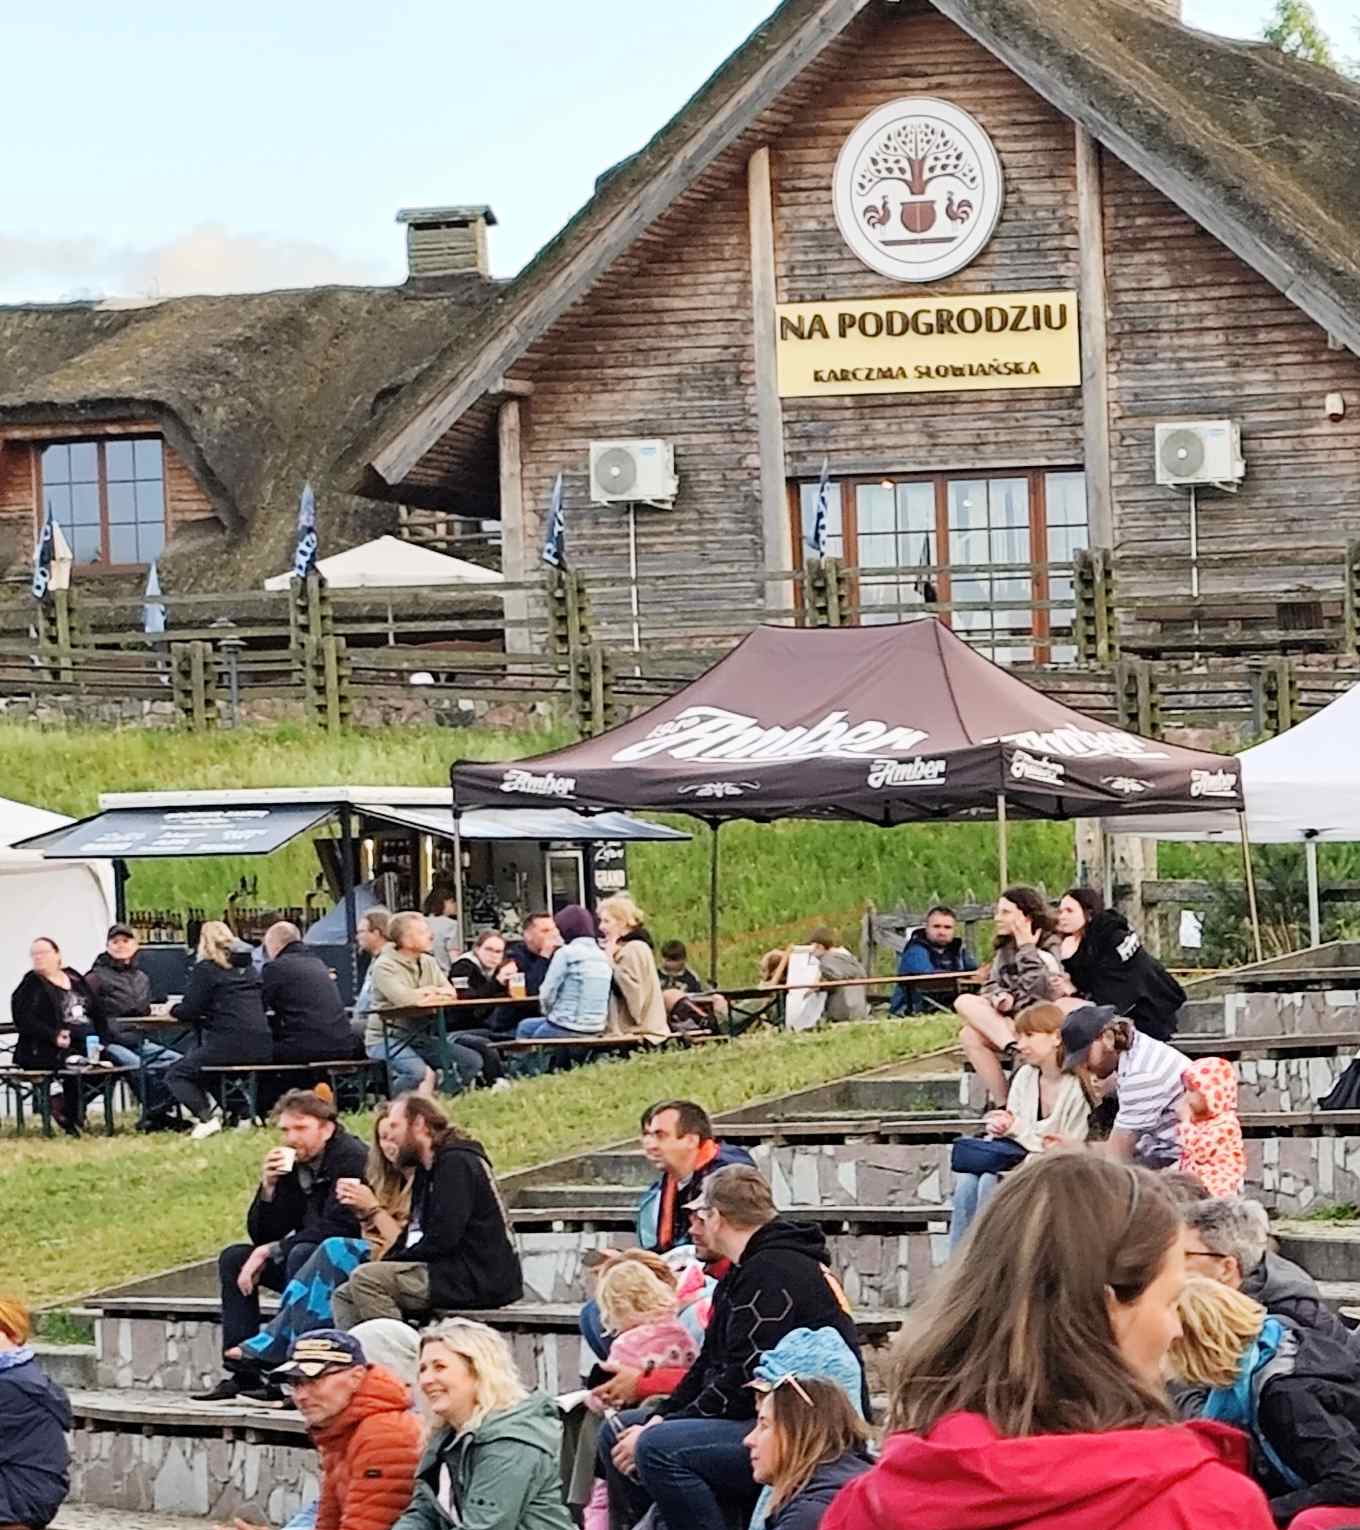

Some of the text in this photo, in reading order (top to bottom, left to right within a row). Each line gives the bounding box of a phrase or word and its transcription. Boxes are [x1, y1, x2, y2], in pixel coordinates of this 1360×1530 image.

[780, 304, 1067, 341] NA PODGRODZIU
[813, 358, 1040, 382] KARCZMA SŁOWIAŃSKA
[612, 705, 929, 763] Amber
[500, 769, 576, 799] Amber
[868, 756, 946, 788] Amber
